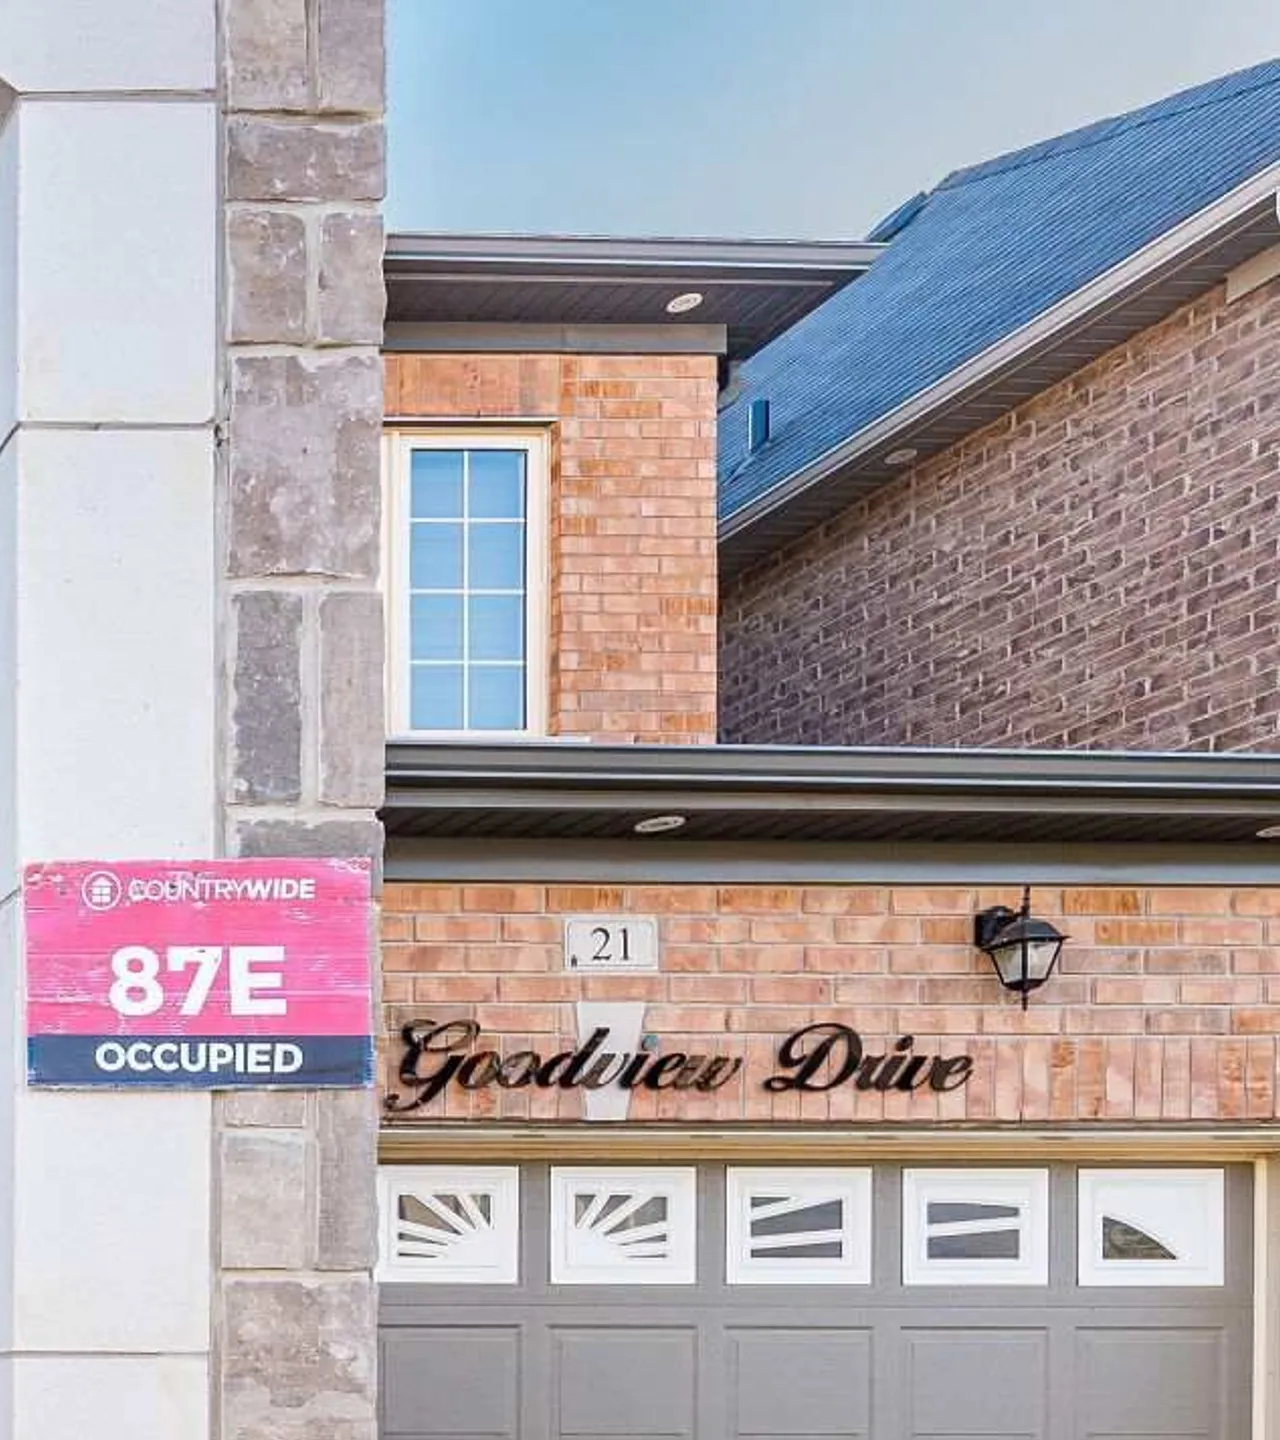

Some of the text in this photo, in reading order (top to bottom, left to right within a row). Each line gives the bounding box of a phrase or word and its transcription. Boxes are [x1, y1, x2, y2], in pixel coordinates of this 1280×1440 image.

[127, 878, 316, 902] COUNTRYWIDE
[591, 927, 630, 961] 21
[108, 946, 287, 1016] 87E
[95, 1042, 303, 1074] OCCUPIED
[385, 1018, 973, 1112] Goodview Drive
